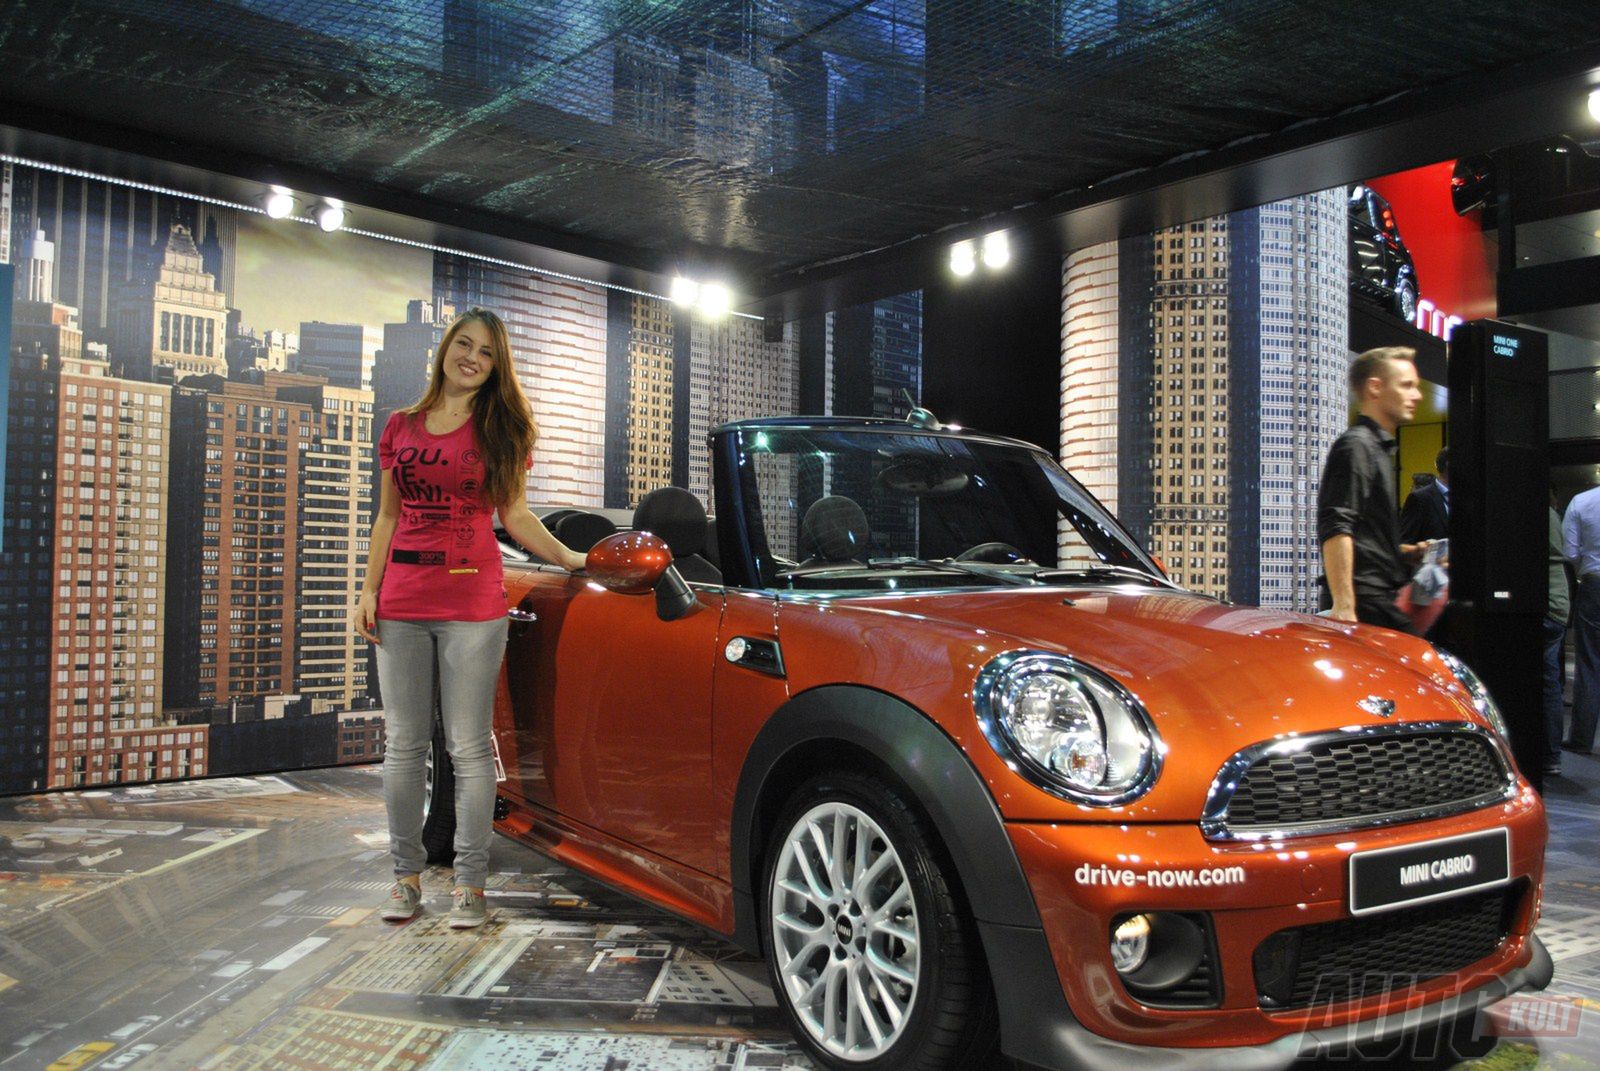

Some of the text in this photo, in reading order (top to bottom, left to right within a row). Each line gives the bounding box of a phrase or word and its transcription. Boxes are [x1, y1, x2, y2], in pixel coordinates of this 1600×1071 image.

[1074, 862, 1246, 888] drive-now.com
[1400, 854, 1474, 886] MINI CABRIO
